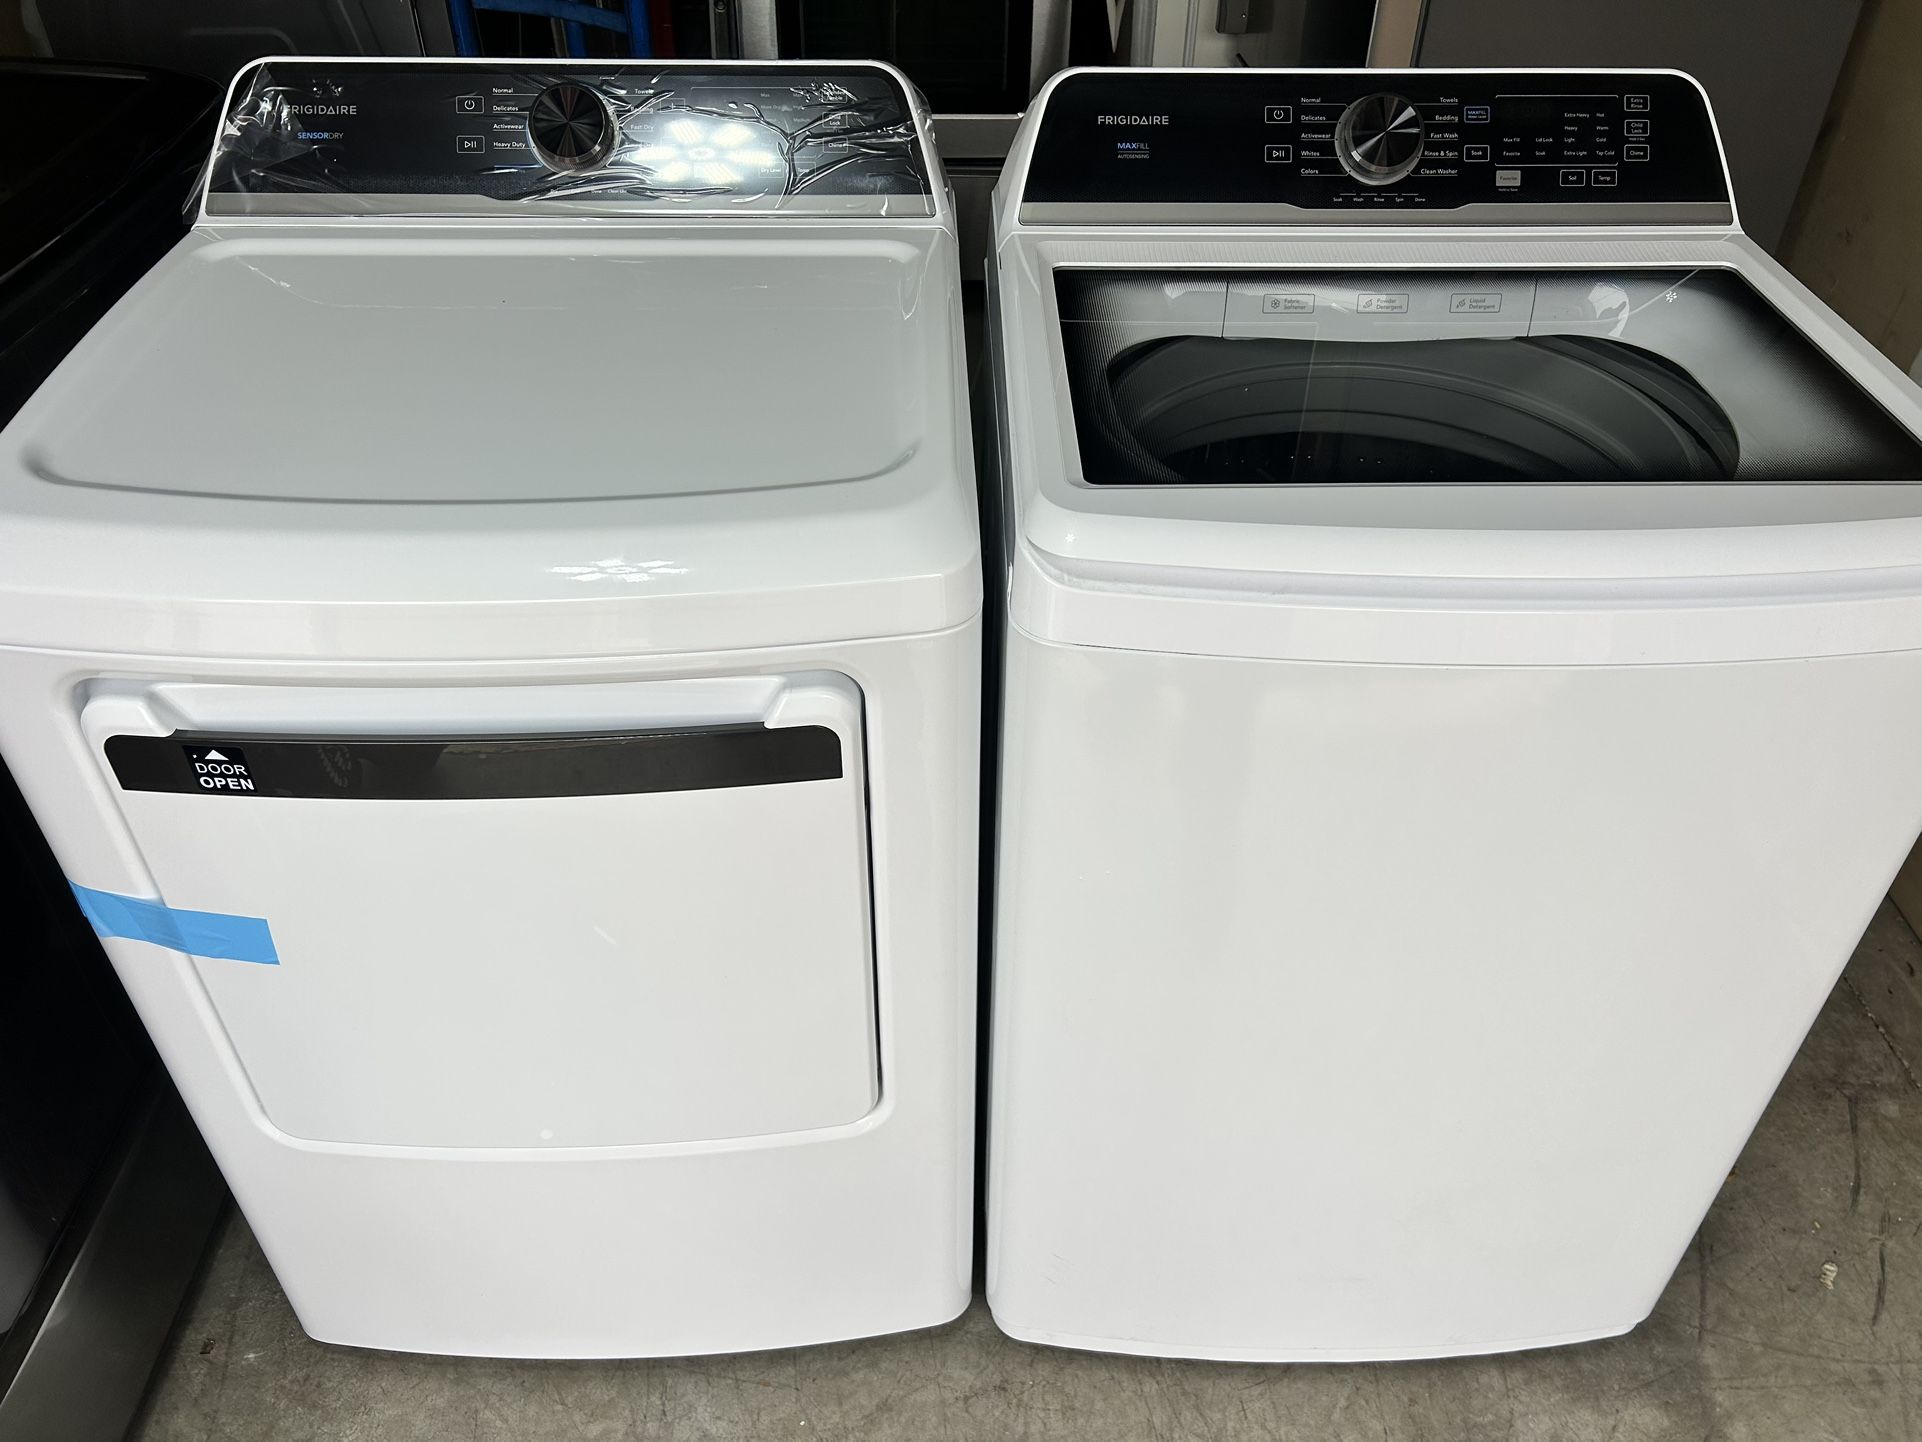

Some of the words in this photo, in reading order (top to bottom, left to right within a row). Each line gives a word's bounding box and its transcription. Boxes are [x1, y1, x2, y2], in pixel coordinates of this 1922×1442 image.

[1098, 115, 1169, 124] FRIGIDAIRE
[195, 763, 248, 775] DOOR
[200, 777, 254, 790] OPEN
